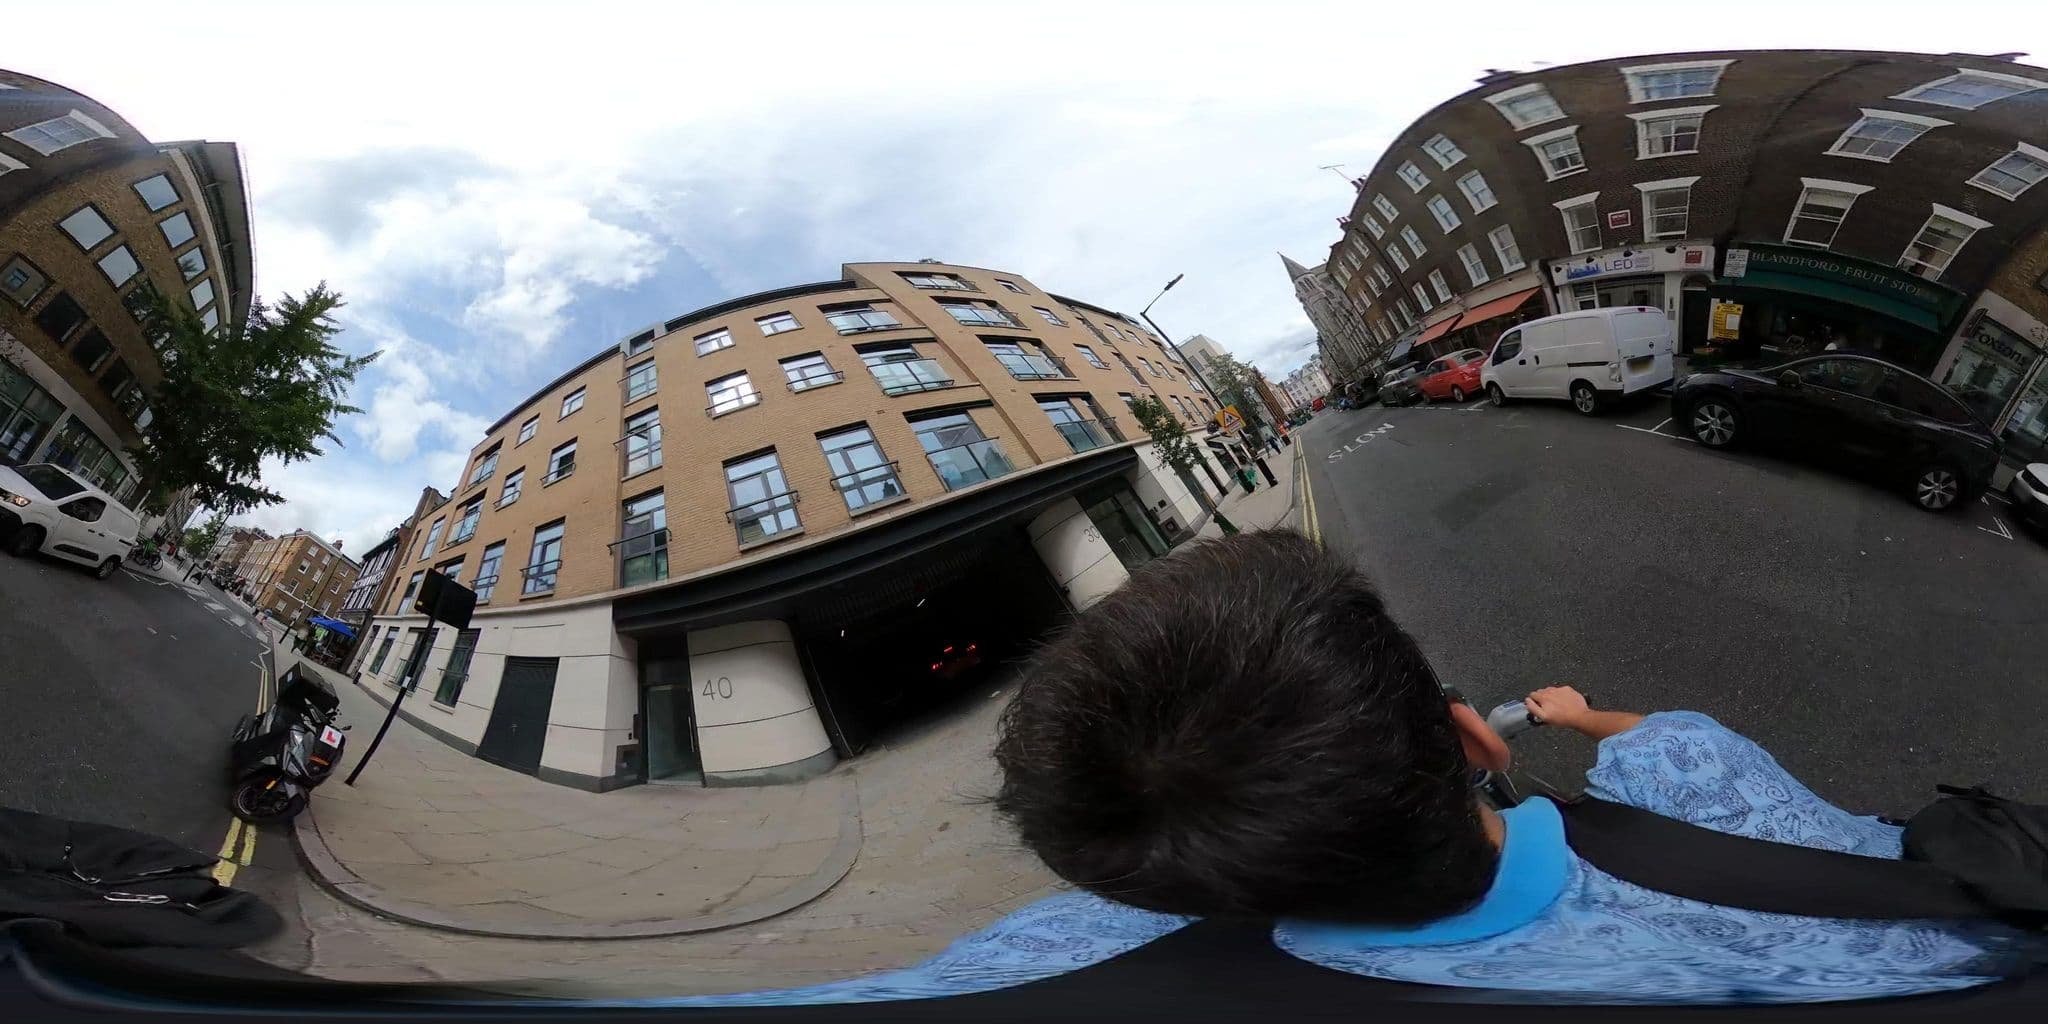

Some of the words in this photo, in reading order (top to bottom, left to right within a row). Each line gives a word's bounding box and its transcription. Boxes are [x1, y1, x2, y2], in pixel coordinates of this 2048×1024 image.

[1604, 259, 1633, 272] LED
[1752, 251, 1840, 274] BLANDFORD
[1844, 265, 1889, 285] FRUIT
[1328, 422, 1395, 464] SLOW
[1083, 525, 1101, 543] 30
[702, 676, 733, 701] 40
[326, 729, 337, 744] L
